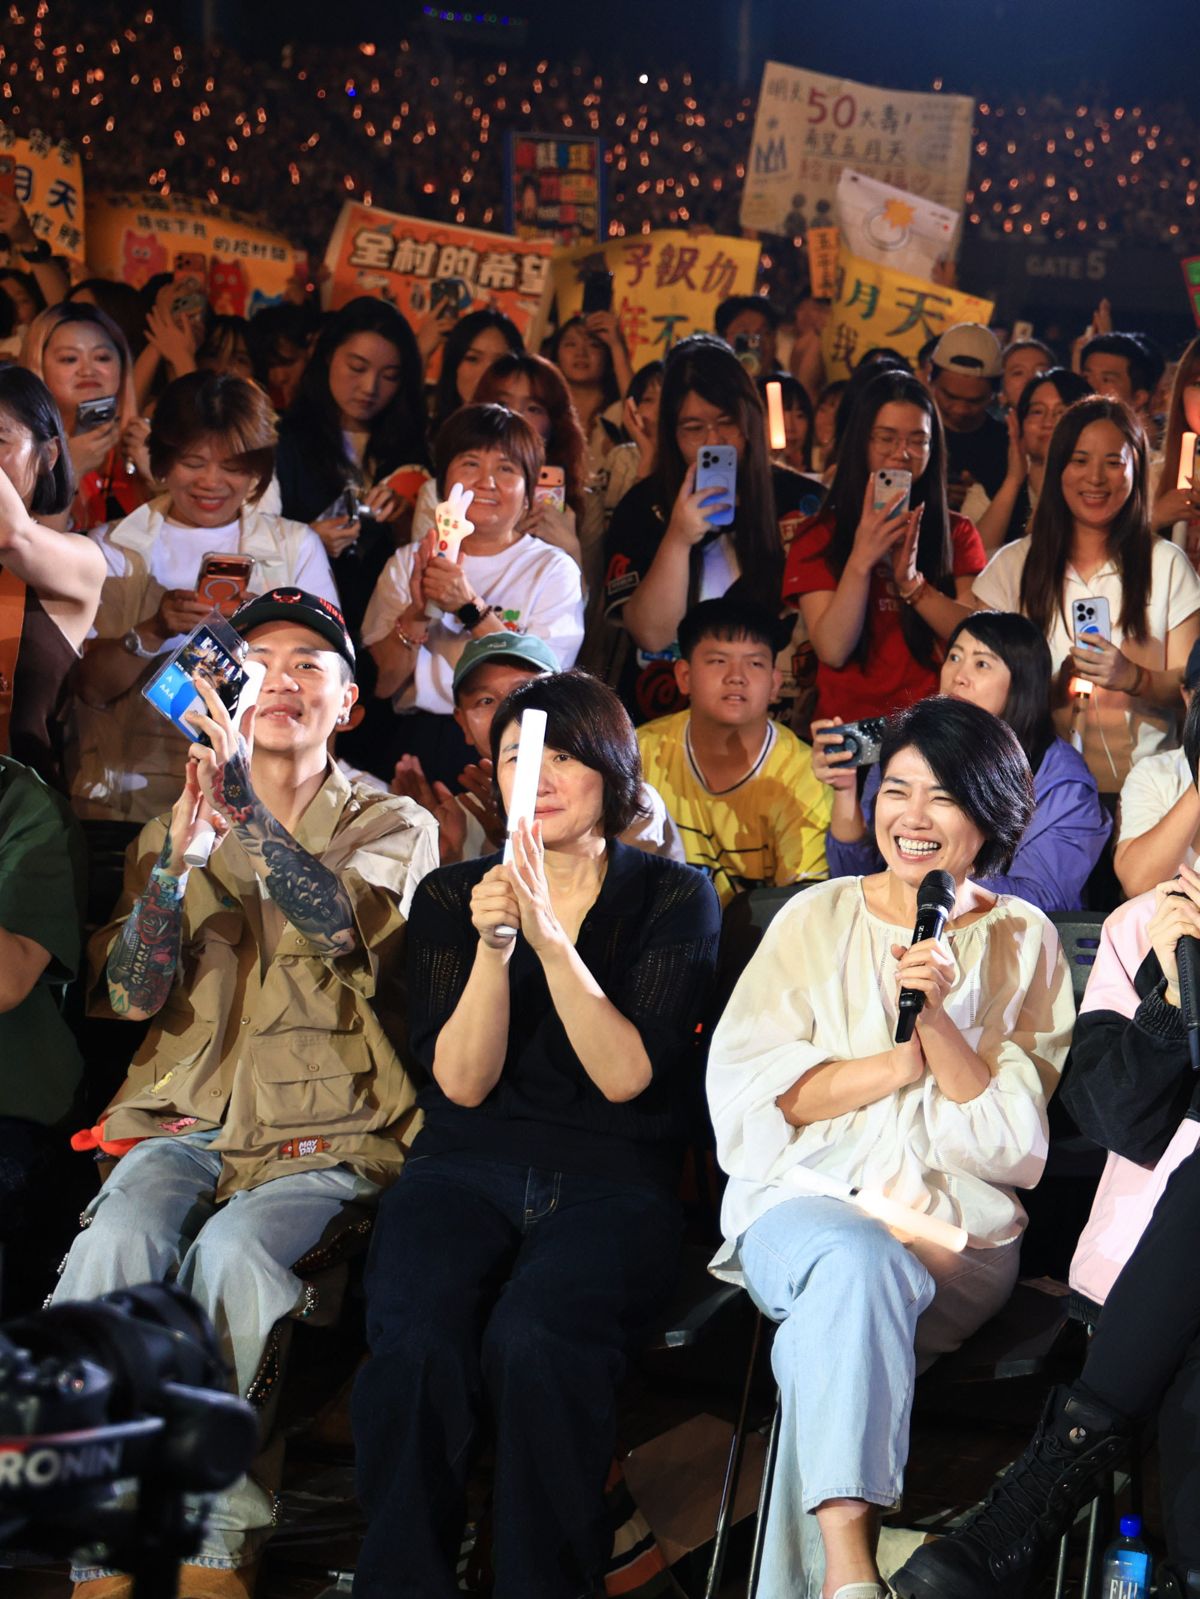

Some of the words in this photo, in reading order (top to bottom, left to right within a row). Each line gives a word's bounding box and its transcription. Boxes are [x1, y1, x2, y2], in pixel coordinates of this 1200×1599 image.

[1026, 254, 1083, 279] GATE
[1087, 250, 1106, 280] 5
[298, 1139, 318, 1149] MAY
[299, 1145, 318, 1157] DAY
